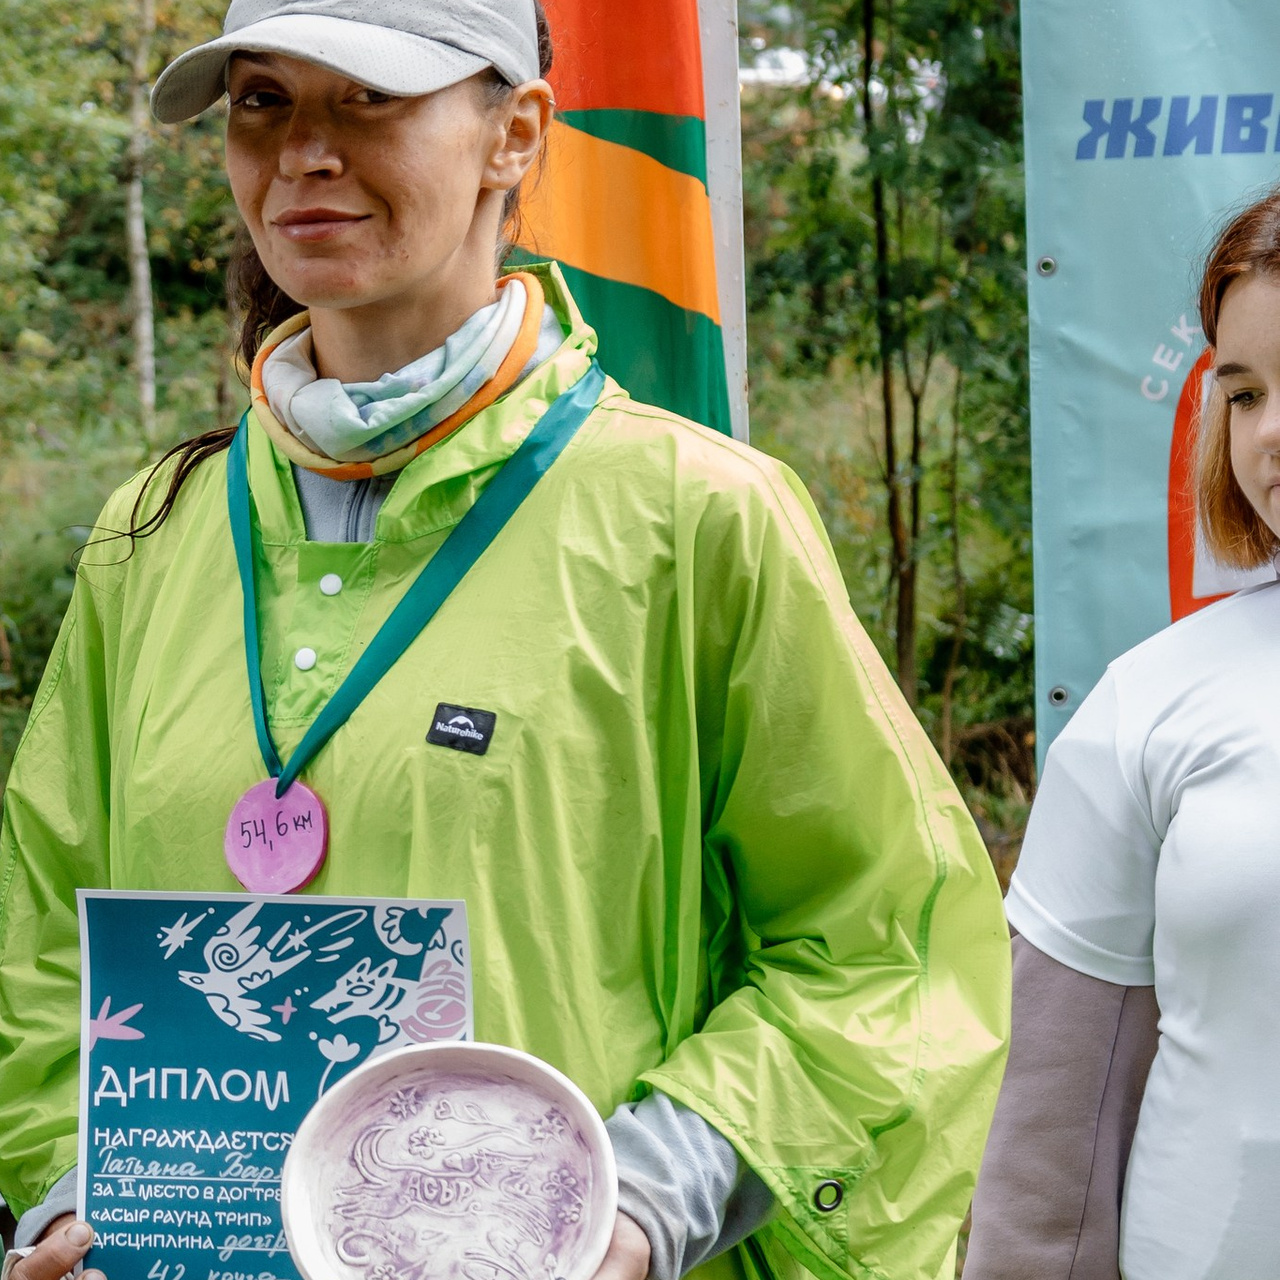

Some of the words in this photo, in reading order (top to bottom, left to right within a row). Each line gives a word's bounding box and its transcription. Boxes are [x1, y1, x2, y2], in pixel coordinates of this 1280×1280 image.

[1075, 93, 1280, 161] ЖИВ
[435, 721, 484, 741] Naturehike
[93, 1065, 290, 1112] ДИПЛОМ
[92, 1182, 114, 1197] ЗА
[138, 1183, 200, 1201] МЕСТО
[203, 1187, 215, 1200] В
[90, 1208, 150, 1223] «АСЫР
[153, 1211, 213, 1229] РАУНД
[215, 1212, 272, 1227] ТРИП»
[92, 1232, 215, 1250] ДИСЦИПЛИНА
